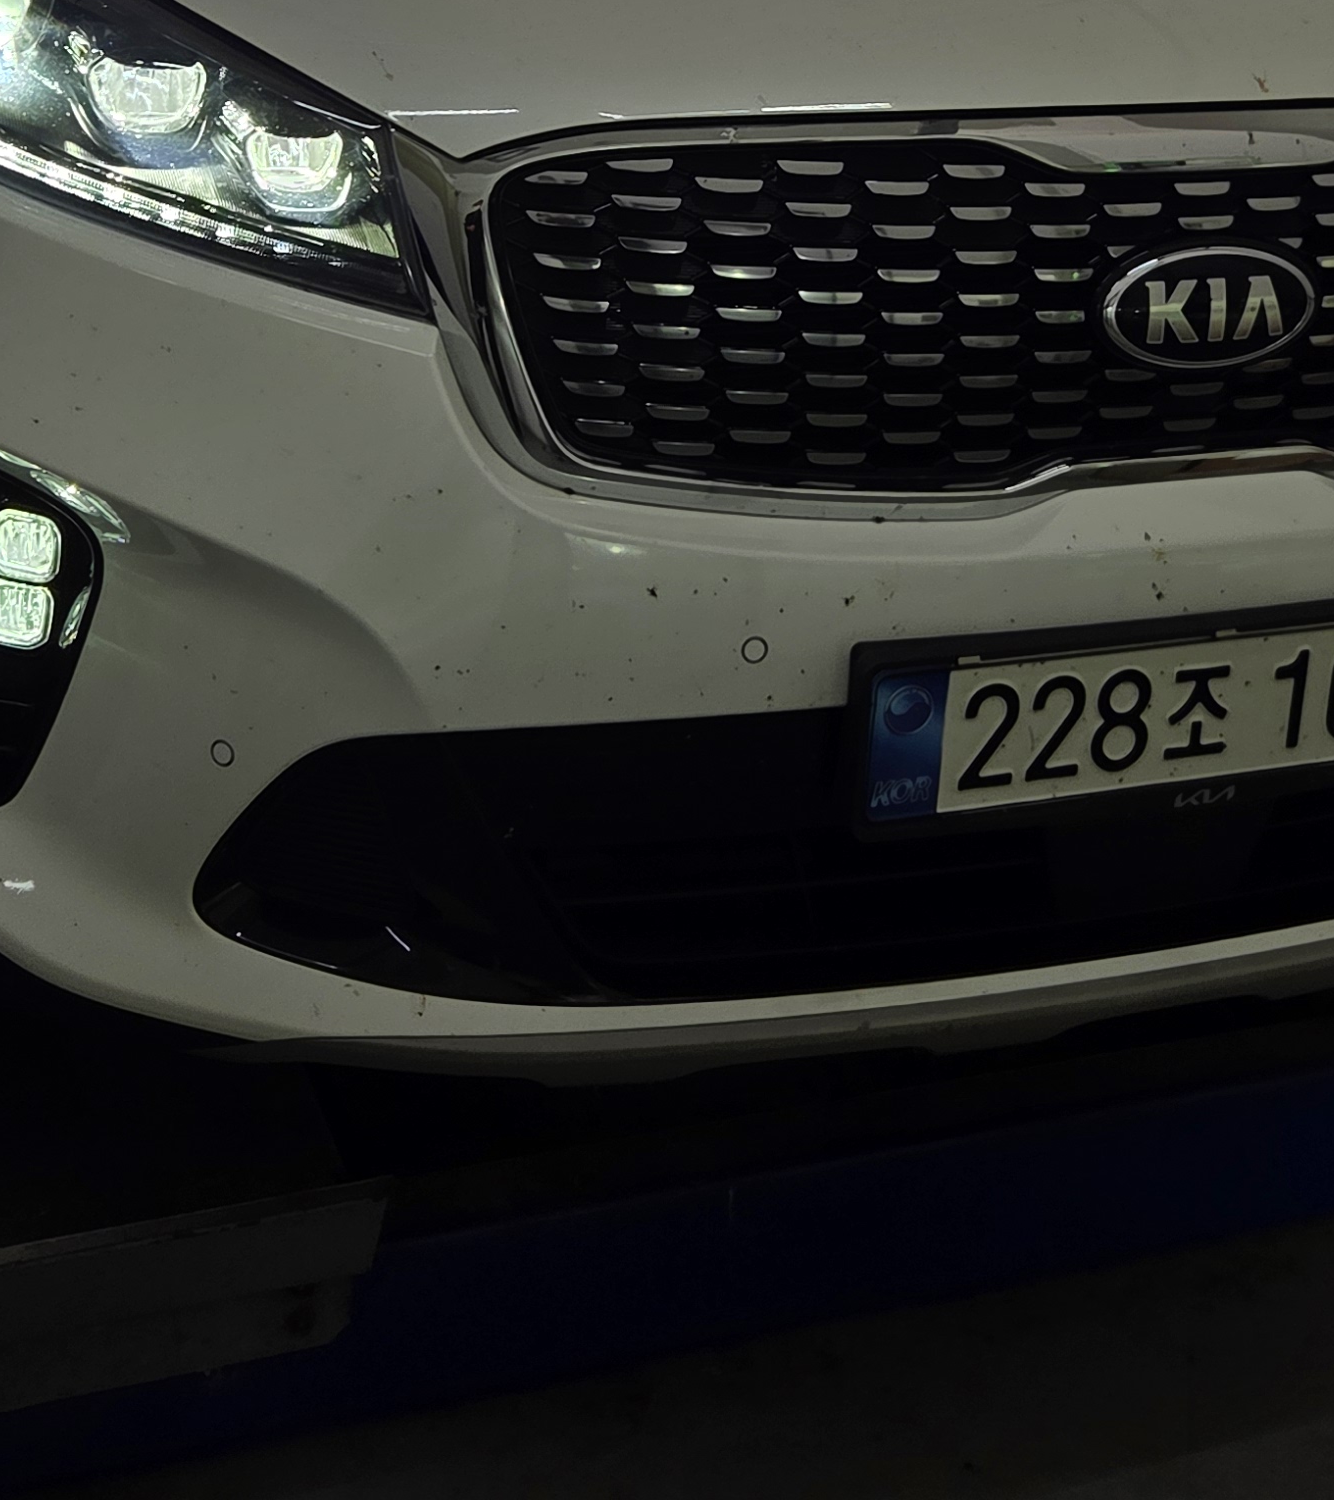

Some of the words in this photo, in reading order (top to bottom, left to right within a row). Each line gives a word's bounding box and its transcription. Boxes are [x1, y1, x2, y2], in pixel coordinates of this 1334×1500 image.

[1145, 275, 1284, 344] KIA
[957, 668, 1232, 791] 228조
[870, 775, 933, 808] KOR
